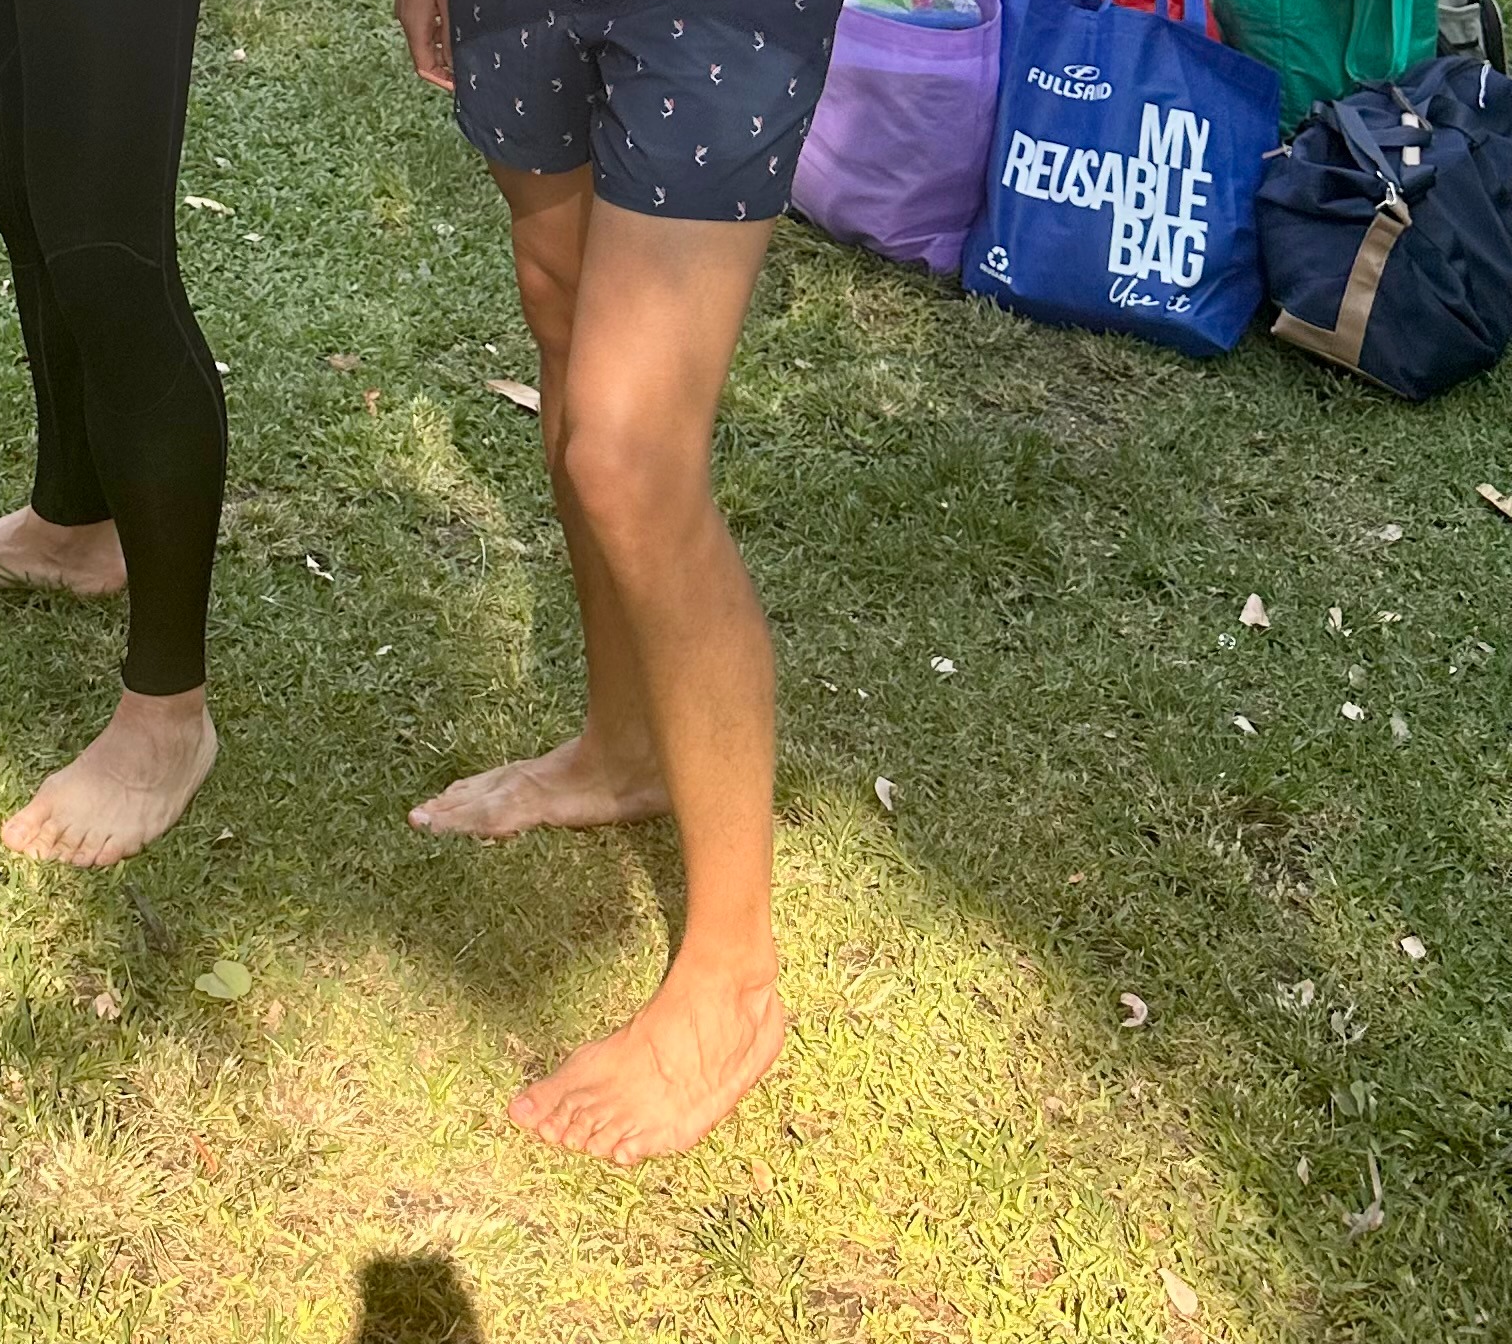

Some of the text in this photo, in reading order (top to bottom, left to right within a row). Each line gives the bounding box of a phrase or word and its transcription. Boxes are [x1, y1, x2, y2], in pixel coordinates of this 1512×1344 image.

[1139, 102, 1211, 173] MY
[1001, 129, 1213, 232] REUSABLE
[1107, 214, 1207, 288] BAG
[1108, 276, 1192, 313] Use it
